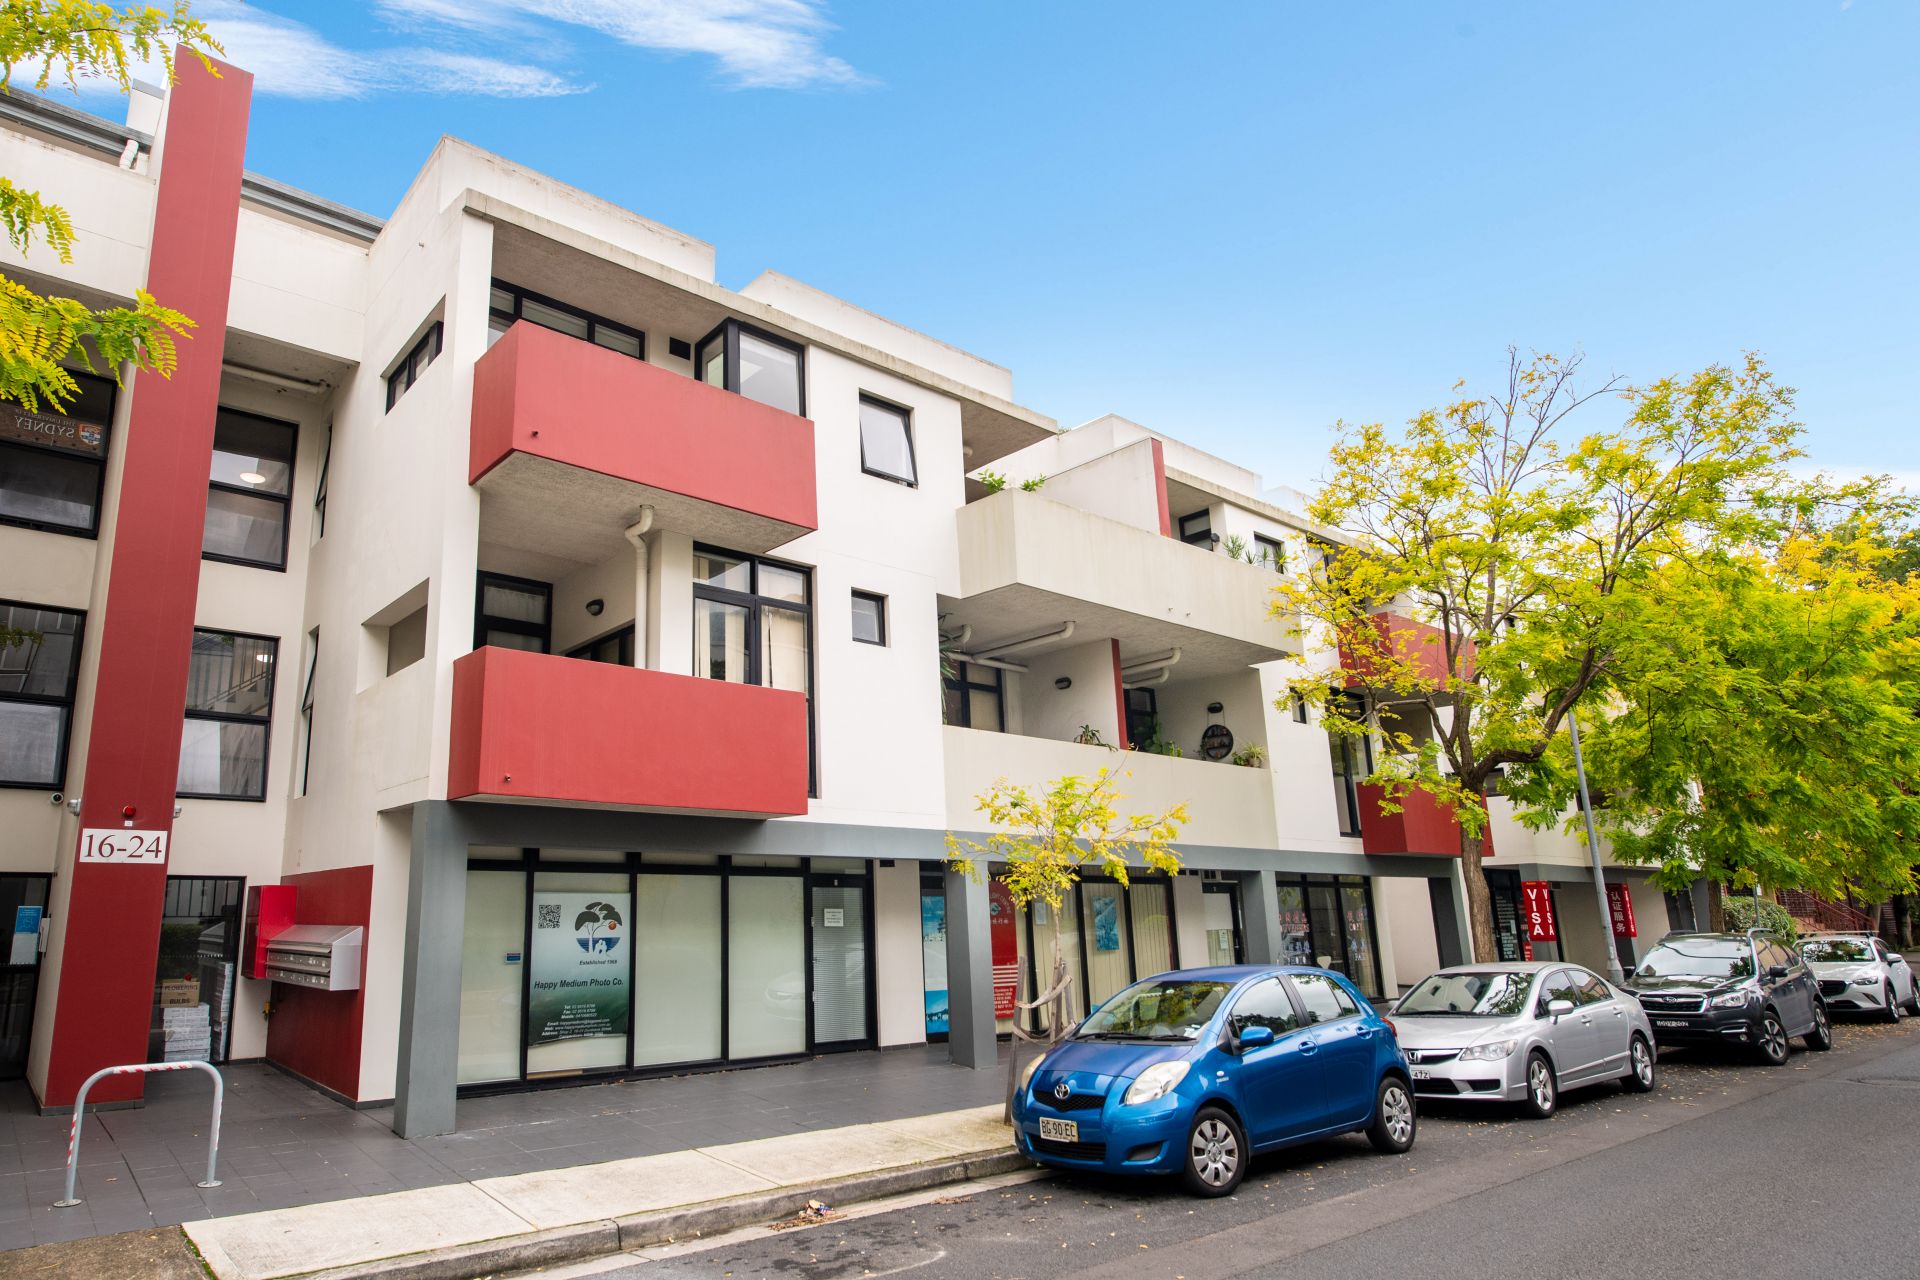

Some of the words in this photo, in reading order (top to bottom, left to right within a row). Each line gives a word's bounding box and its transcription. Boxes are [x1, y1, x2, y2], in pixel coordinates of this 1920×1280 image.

[83, 833, 162, 858] 16-24
[1526, 888, 1545, 936] VISA
[1542, 888, 1555, 936] VISA
[1610, 891, 1626, 933] 认证服务
[534, 980, 557, 990] Happy
[559, 979, 588, 988] Medium
[589, 978, 611, 987] Photo
[612, 977, 624, 986] Co.
